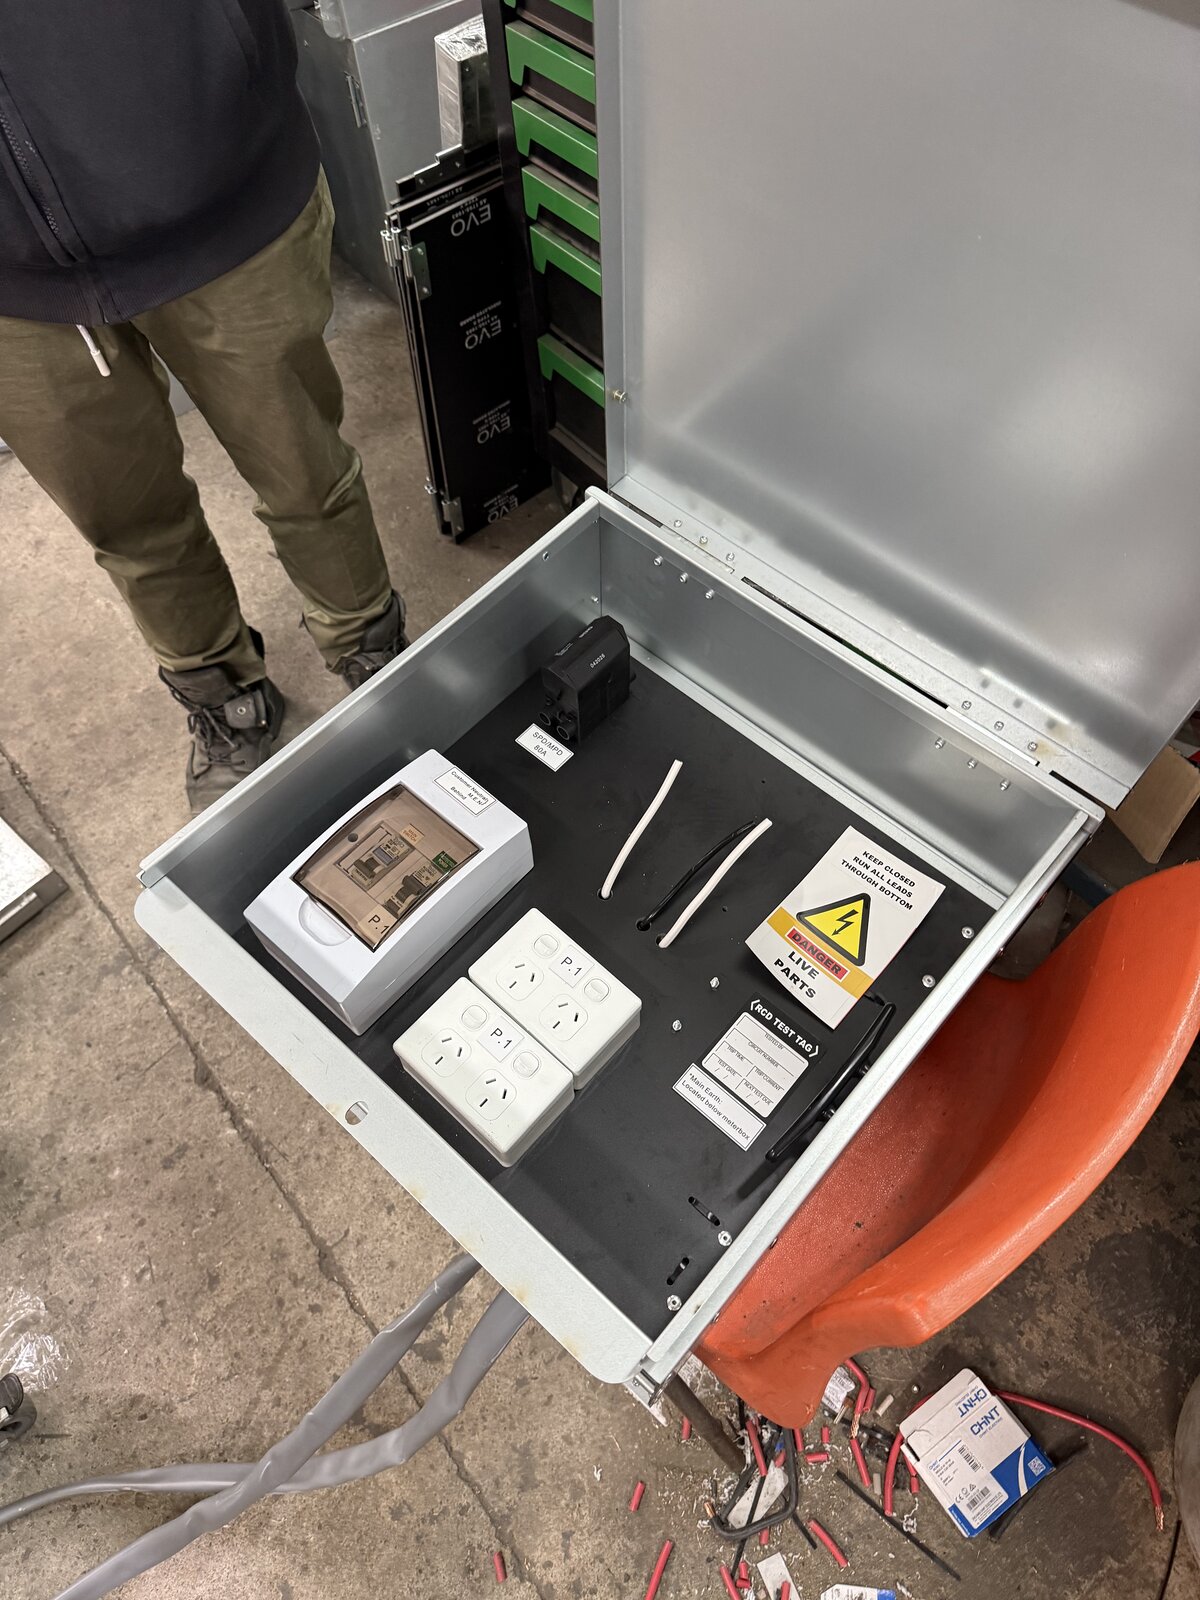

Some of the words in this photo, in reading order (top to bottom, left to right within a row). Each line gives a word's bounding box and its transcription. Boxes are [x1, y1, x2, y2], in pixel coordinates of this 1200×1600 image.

[450, 203, 492, 237] EVO
[464, 318, 502, 350] EVO
[476, 416, 511, 444] EVO
[488, 495, 519, 524] EVO
[532, 731, 563, 756] SPD/MPD
[534, 745, 546, 757] 80A
[450, 786, 467, 800] Behind
[451, 771, 472, 789] Customer
[471, 787, 488, 802] Neutral
[852, 856, 871, 869] RUN
[870, 867, 885, 881] ALL
[886, 876, 913, 898] LEADS
[863, 851, 883, 867] KEEP
[884, 865, 916, 887] CLOSED
[841, 860, 878, 888] THROUGH
[879, 886, 913, 910] BOTTOM
[368, 915, 389, 934] P.1
[560, 956, 581, 976] P.1
[788, 951, 819, 979] LIVE
[791, 933, 842, 974] DANGER
[773, 958, 816, 999] PARTS
[490, 1028, 512, 1049] P.1
[765, 1034, 778, 1046] TESTED
[774, 1016, 795, 1038] TEST
[727, 1046, 737, 1054] TRIP
[735, 1053, 745, 1061] TIME
[748, 1042, 764, 1056] CIRCUIT
[762, 1052, 778, 1068] NUMBER
[717, 1060, 727, 1069] TEST
[726, 1066, 737, 1076] DATE
[754, 1069, 765, 1078] TRIP
[764, 1076, 782, 1091] CURRENT
[704, 1088, 723, 1104] Earth:
[744, 1081, 754, 1090] NEXT
[753, 1088, 763, 1098] TEST
[762, 1096, 772, 1105] DUE
[681, 1081, 704, 1102] Located
[704, 1100, 723, 1116] below
[722, 1114, 750, 1140] meterbox
[960, 1388, 988, 1418] CHINT
[970, 1406, 1000, 1436] CHINT
